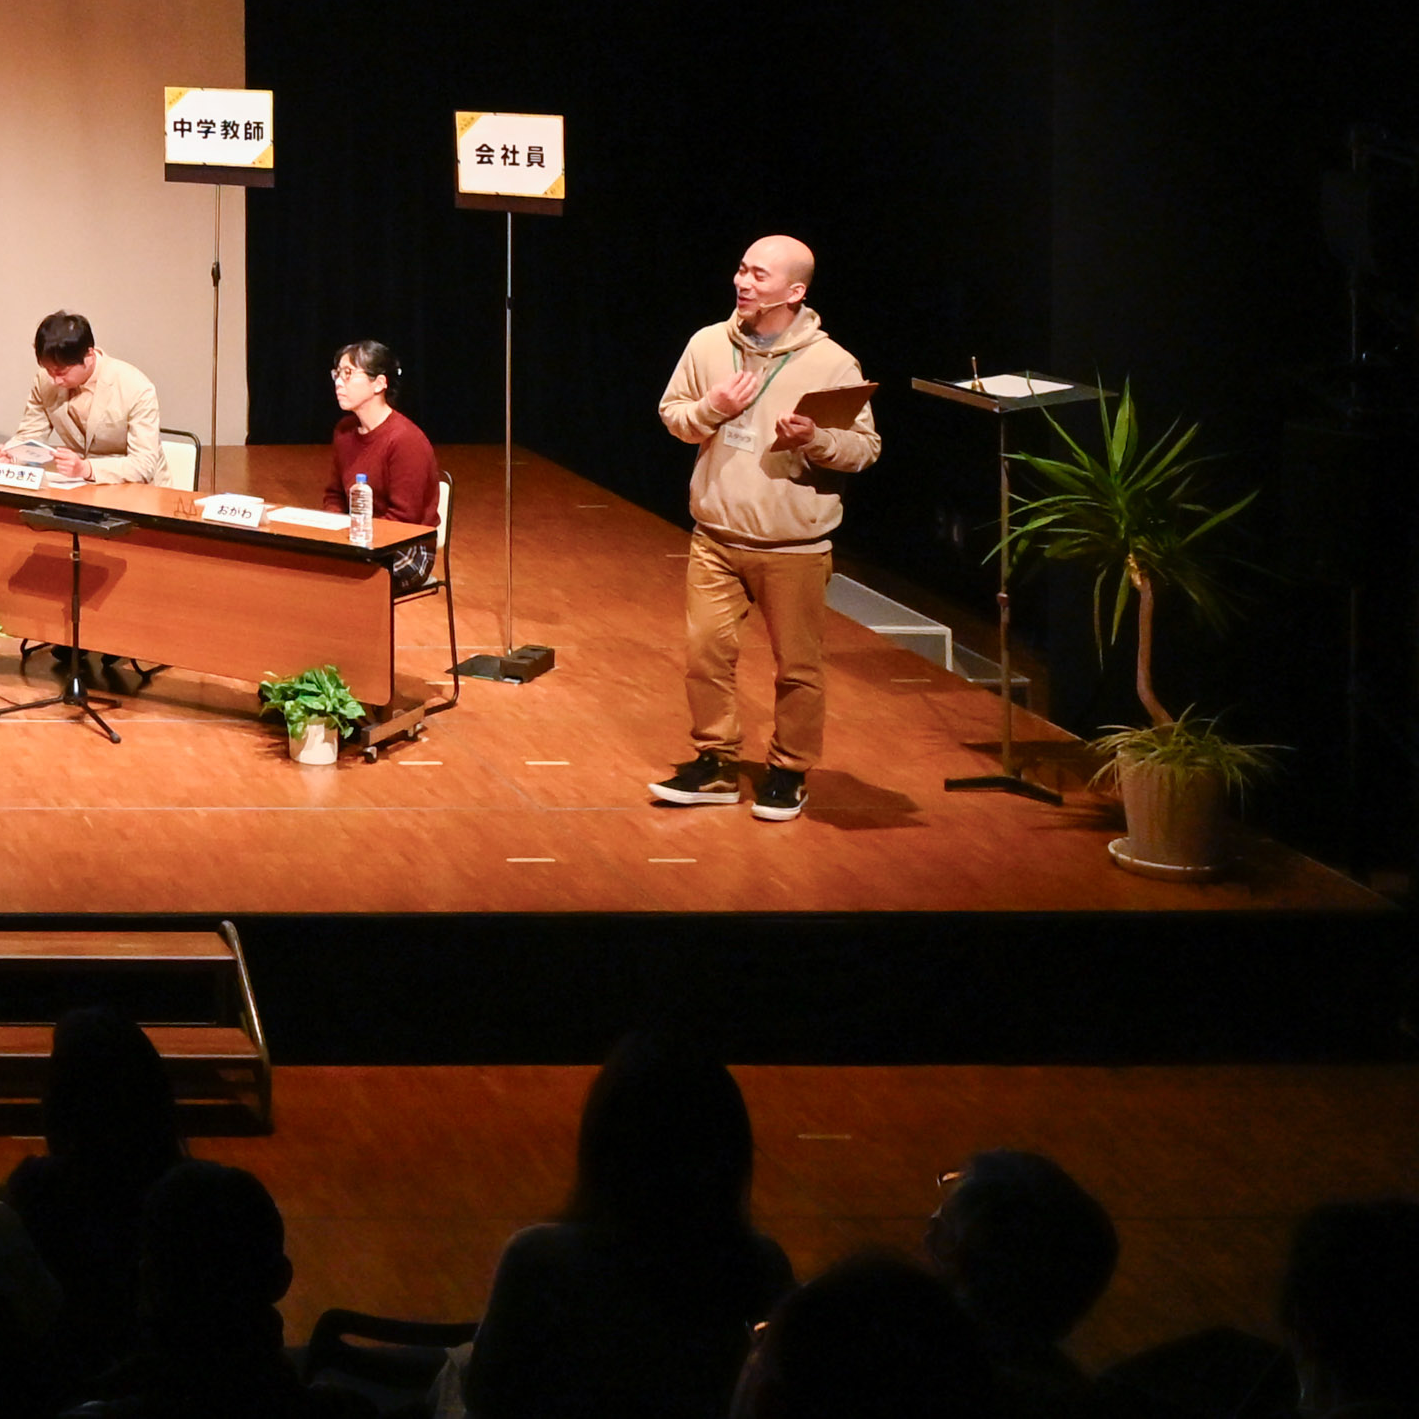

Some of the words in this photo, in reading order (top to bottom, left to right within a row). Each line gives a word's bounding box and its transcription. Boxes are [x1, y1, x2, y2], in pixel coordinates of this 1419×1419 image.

[172, 118, 265, 142] 中学教師
[475, 143, 546, 169] 会社員
[217, 505, 252, 519] おがわ
